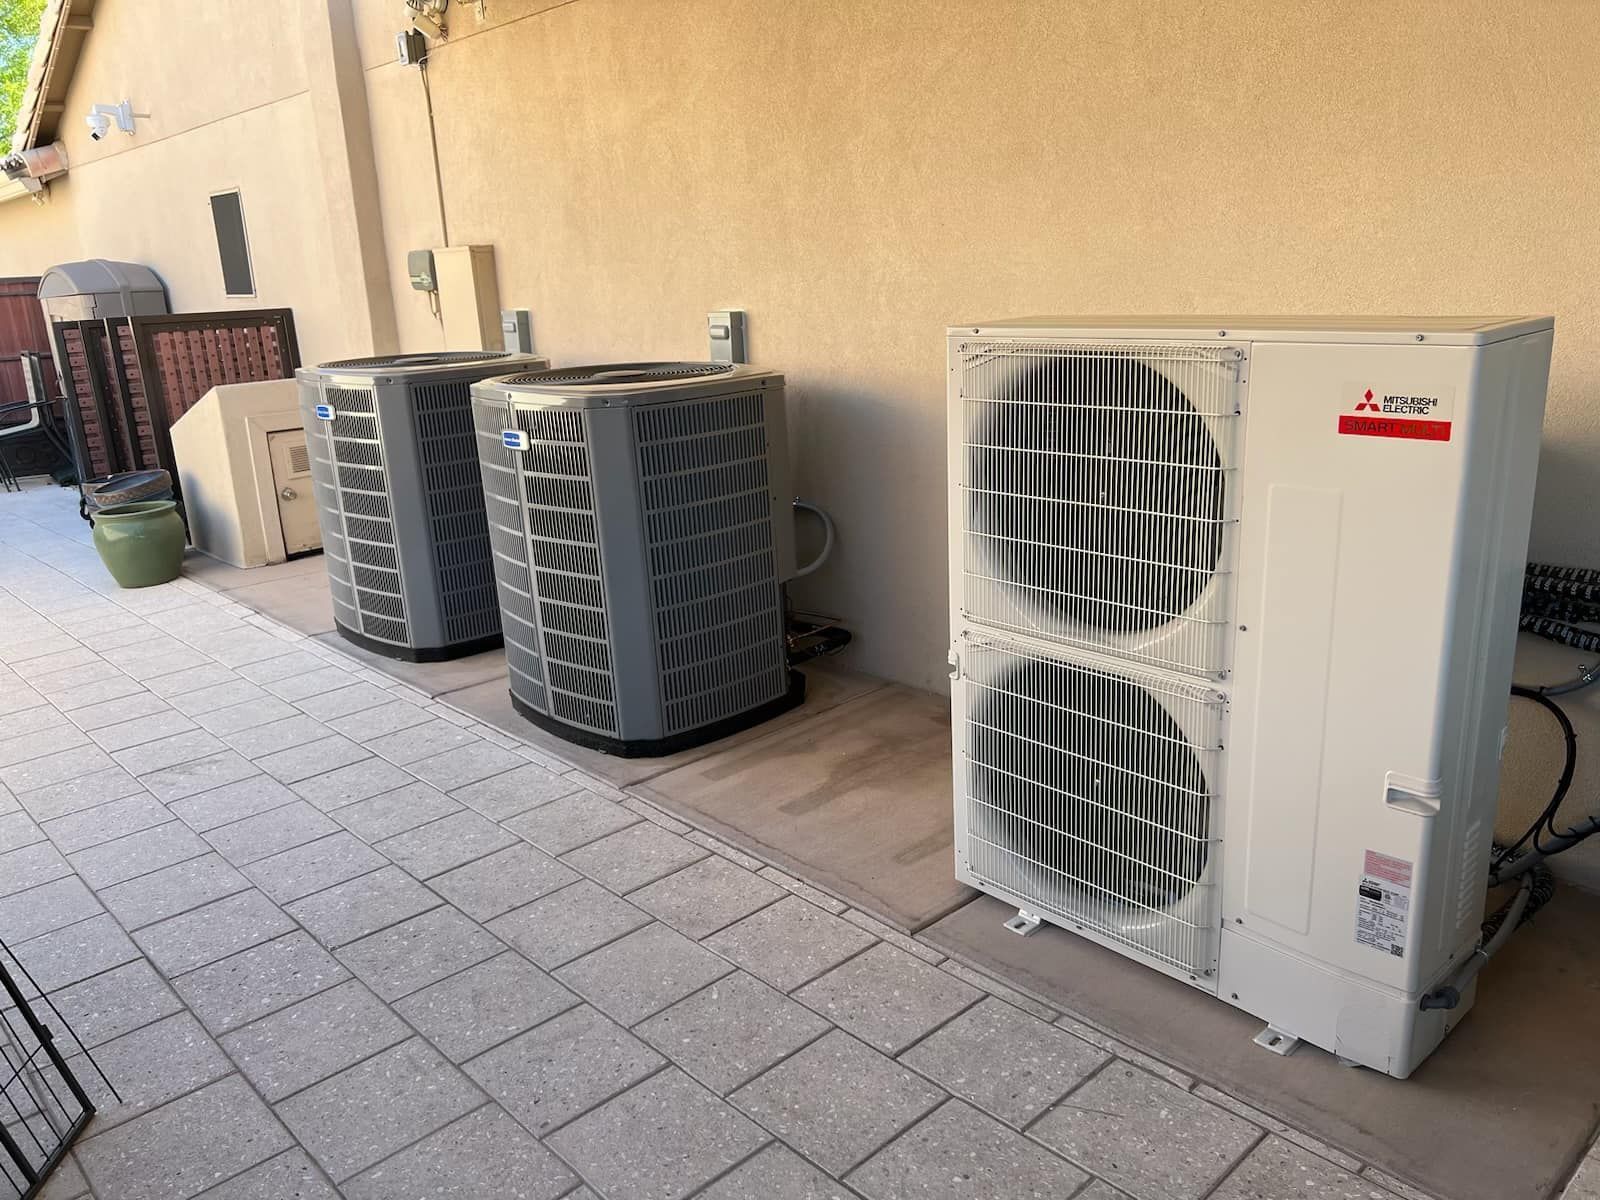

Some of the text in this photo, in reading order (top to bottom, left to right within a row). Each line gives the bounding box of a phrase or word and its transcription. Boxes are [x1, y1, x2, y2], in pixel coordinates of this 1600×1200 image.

[1383, 395, 1438, 406] MITSUBISHI
[1383, 405, 1430, 415] ELECTRIC
[1345, 419, 1395, 433] SMART
